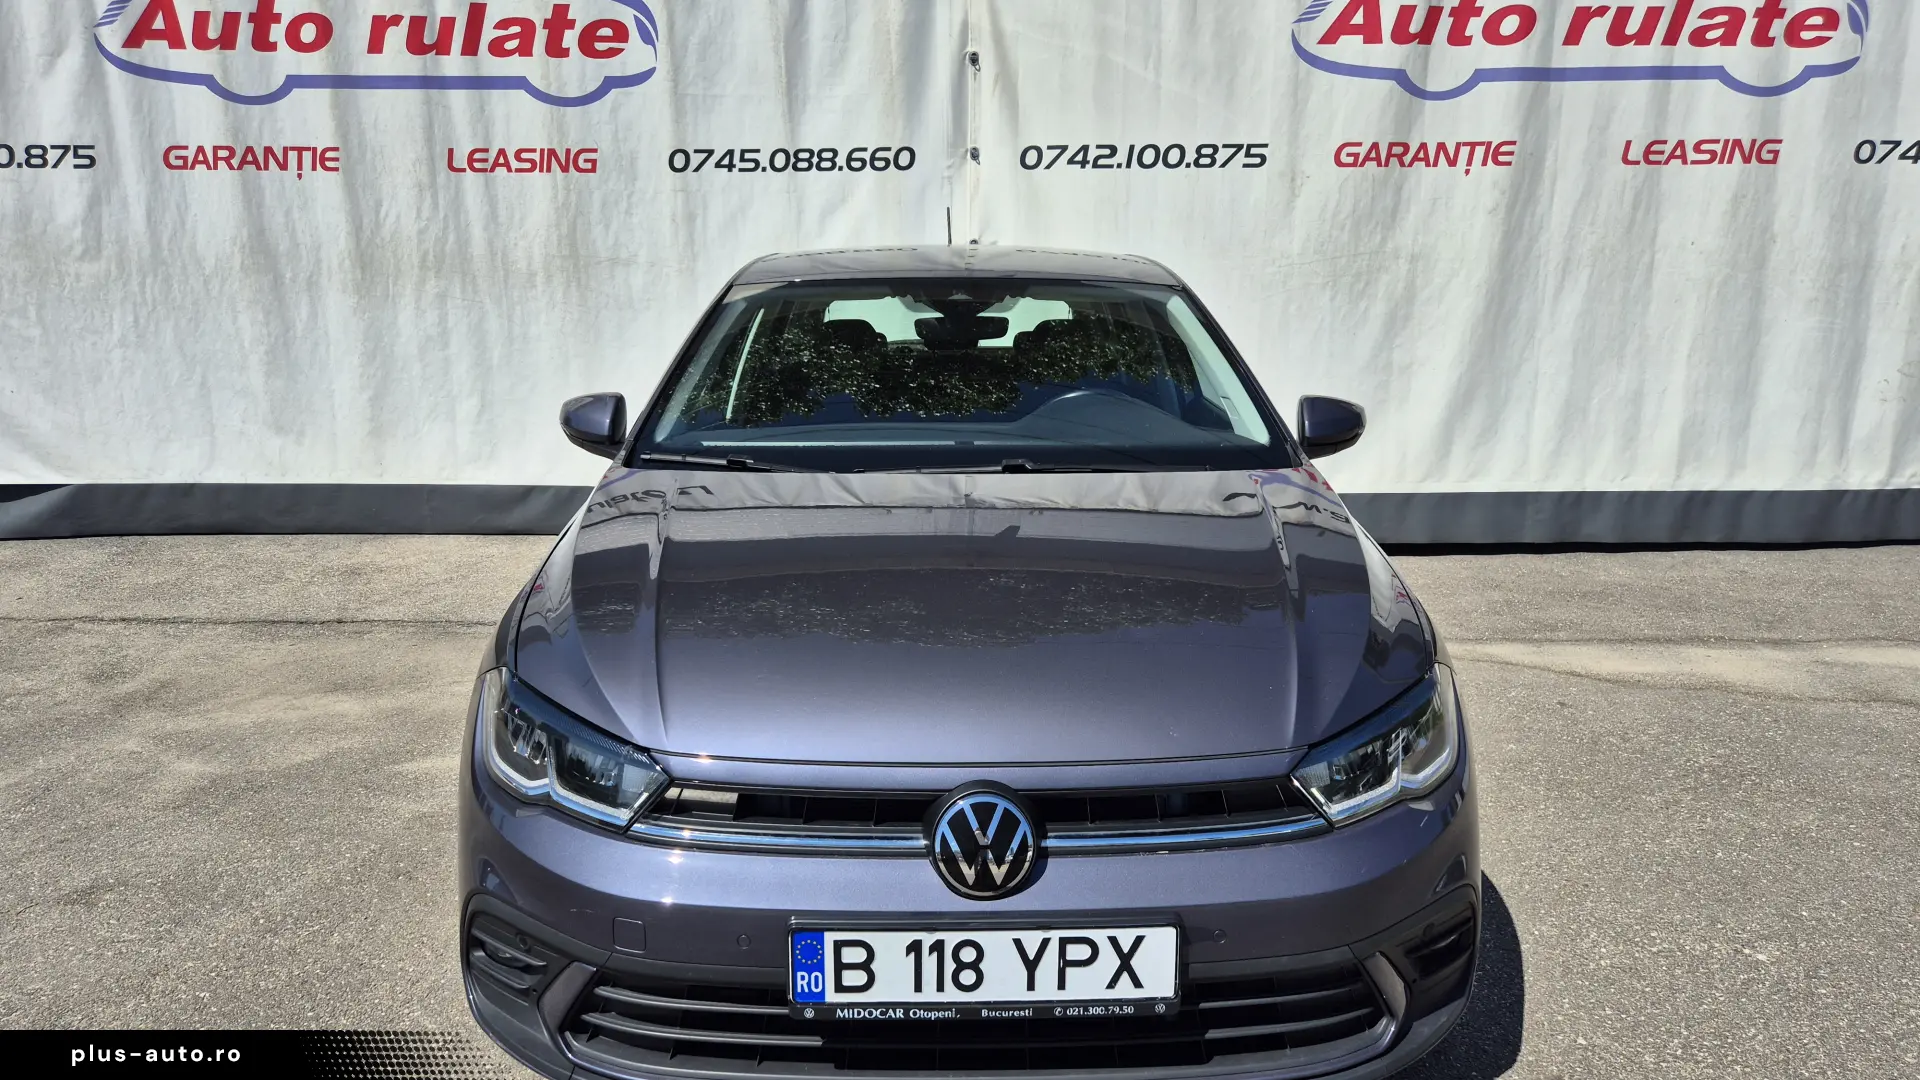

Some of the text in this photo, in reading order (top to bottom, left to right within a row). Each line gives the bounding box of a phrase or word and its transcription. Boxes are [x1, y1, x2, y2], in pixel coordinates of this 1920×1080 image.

[124, 0, 630, 60] Auto rulate
[1317, 0, 1840, 49] Auto rulate
[163, 145, 341, 180] GARANȚIE
[447, 147, 599, 174] LEASING
[668, 146, 916, 173] 0745.088.660
[1019, 143, 1269, 171] 0742.100.875
[1333, 140, 1517, 177] GARANȚIE
[1621, 138, 1783, 167] LEASING
[1853, 139, 1920, 165] 074
[832, 934, 1146, 994] B 118 YPX
[796, 971, 823, 993] RO
[835, 1008, 904, 1019] MIDOCAR
[981, 1008, 1033, 1018] Bucuresti
[1066, 1005, 1135, 1016] 021.300.79.50
